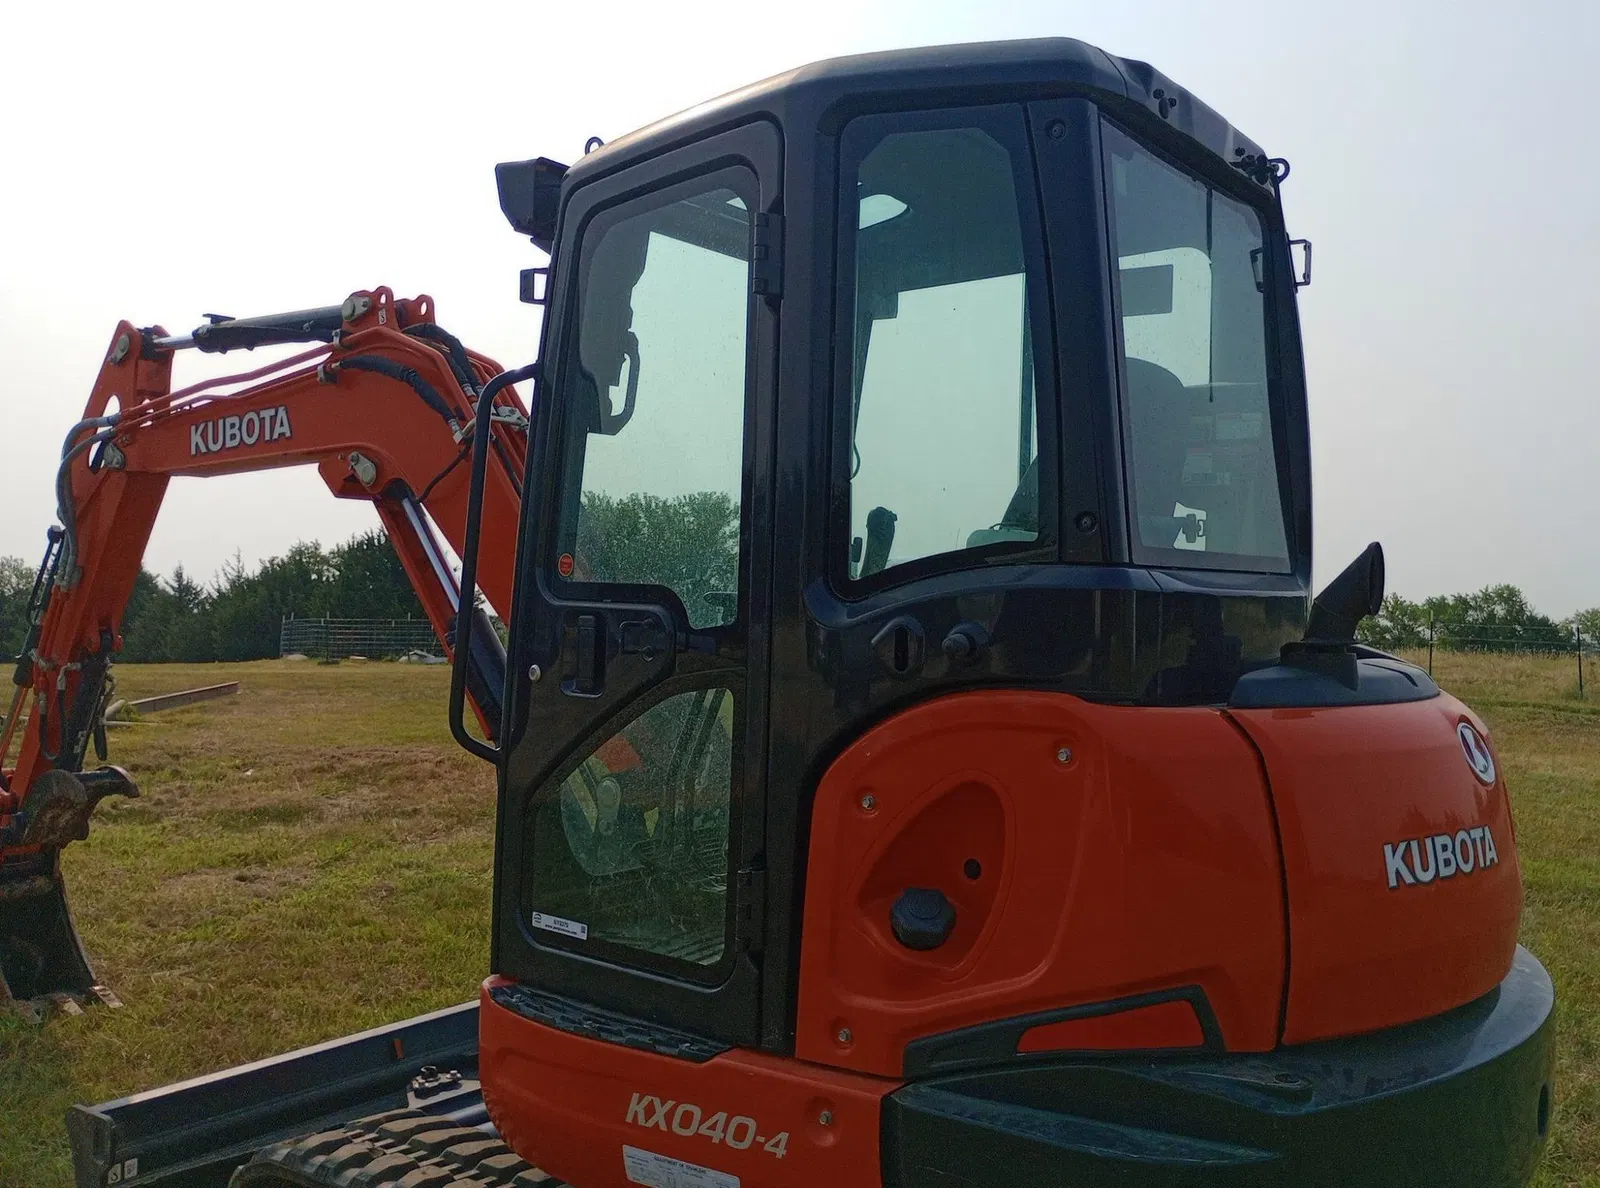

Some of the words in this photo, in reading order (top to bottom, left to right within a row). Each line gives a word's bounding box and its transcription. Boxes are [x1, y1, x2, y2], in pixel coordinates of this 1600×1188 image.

[190, 405, 292, 456] KUBOTA
[1383, 825, 1499, 889] KUBOTA
[625, 1092, 790, 1160] KX040-4
